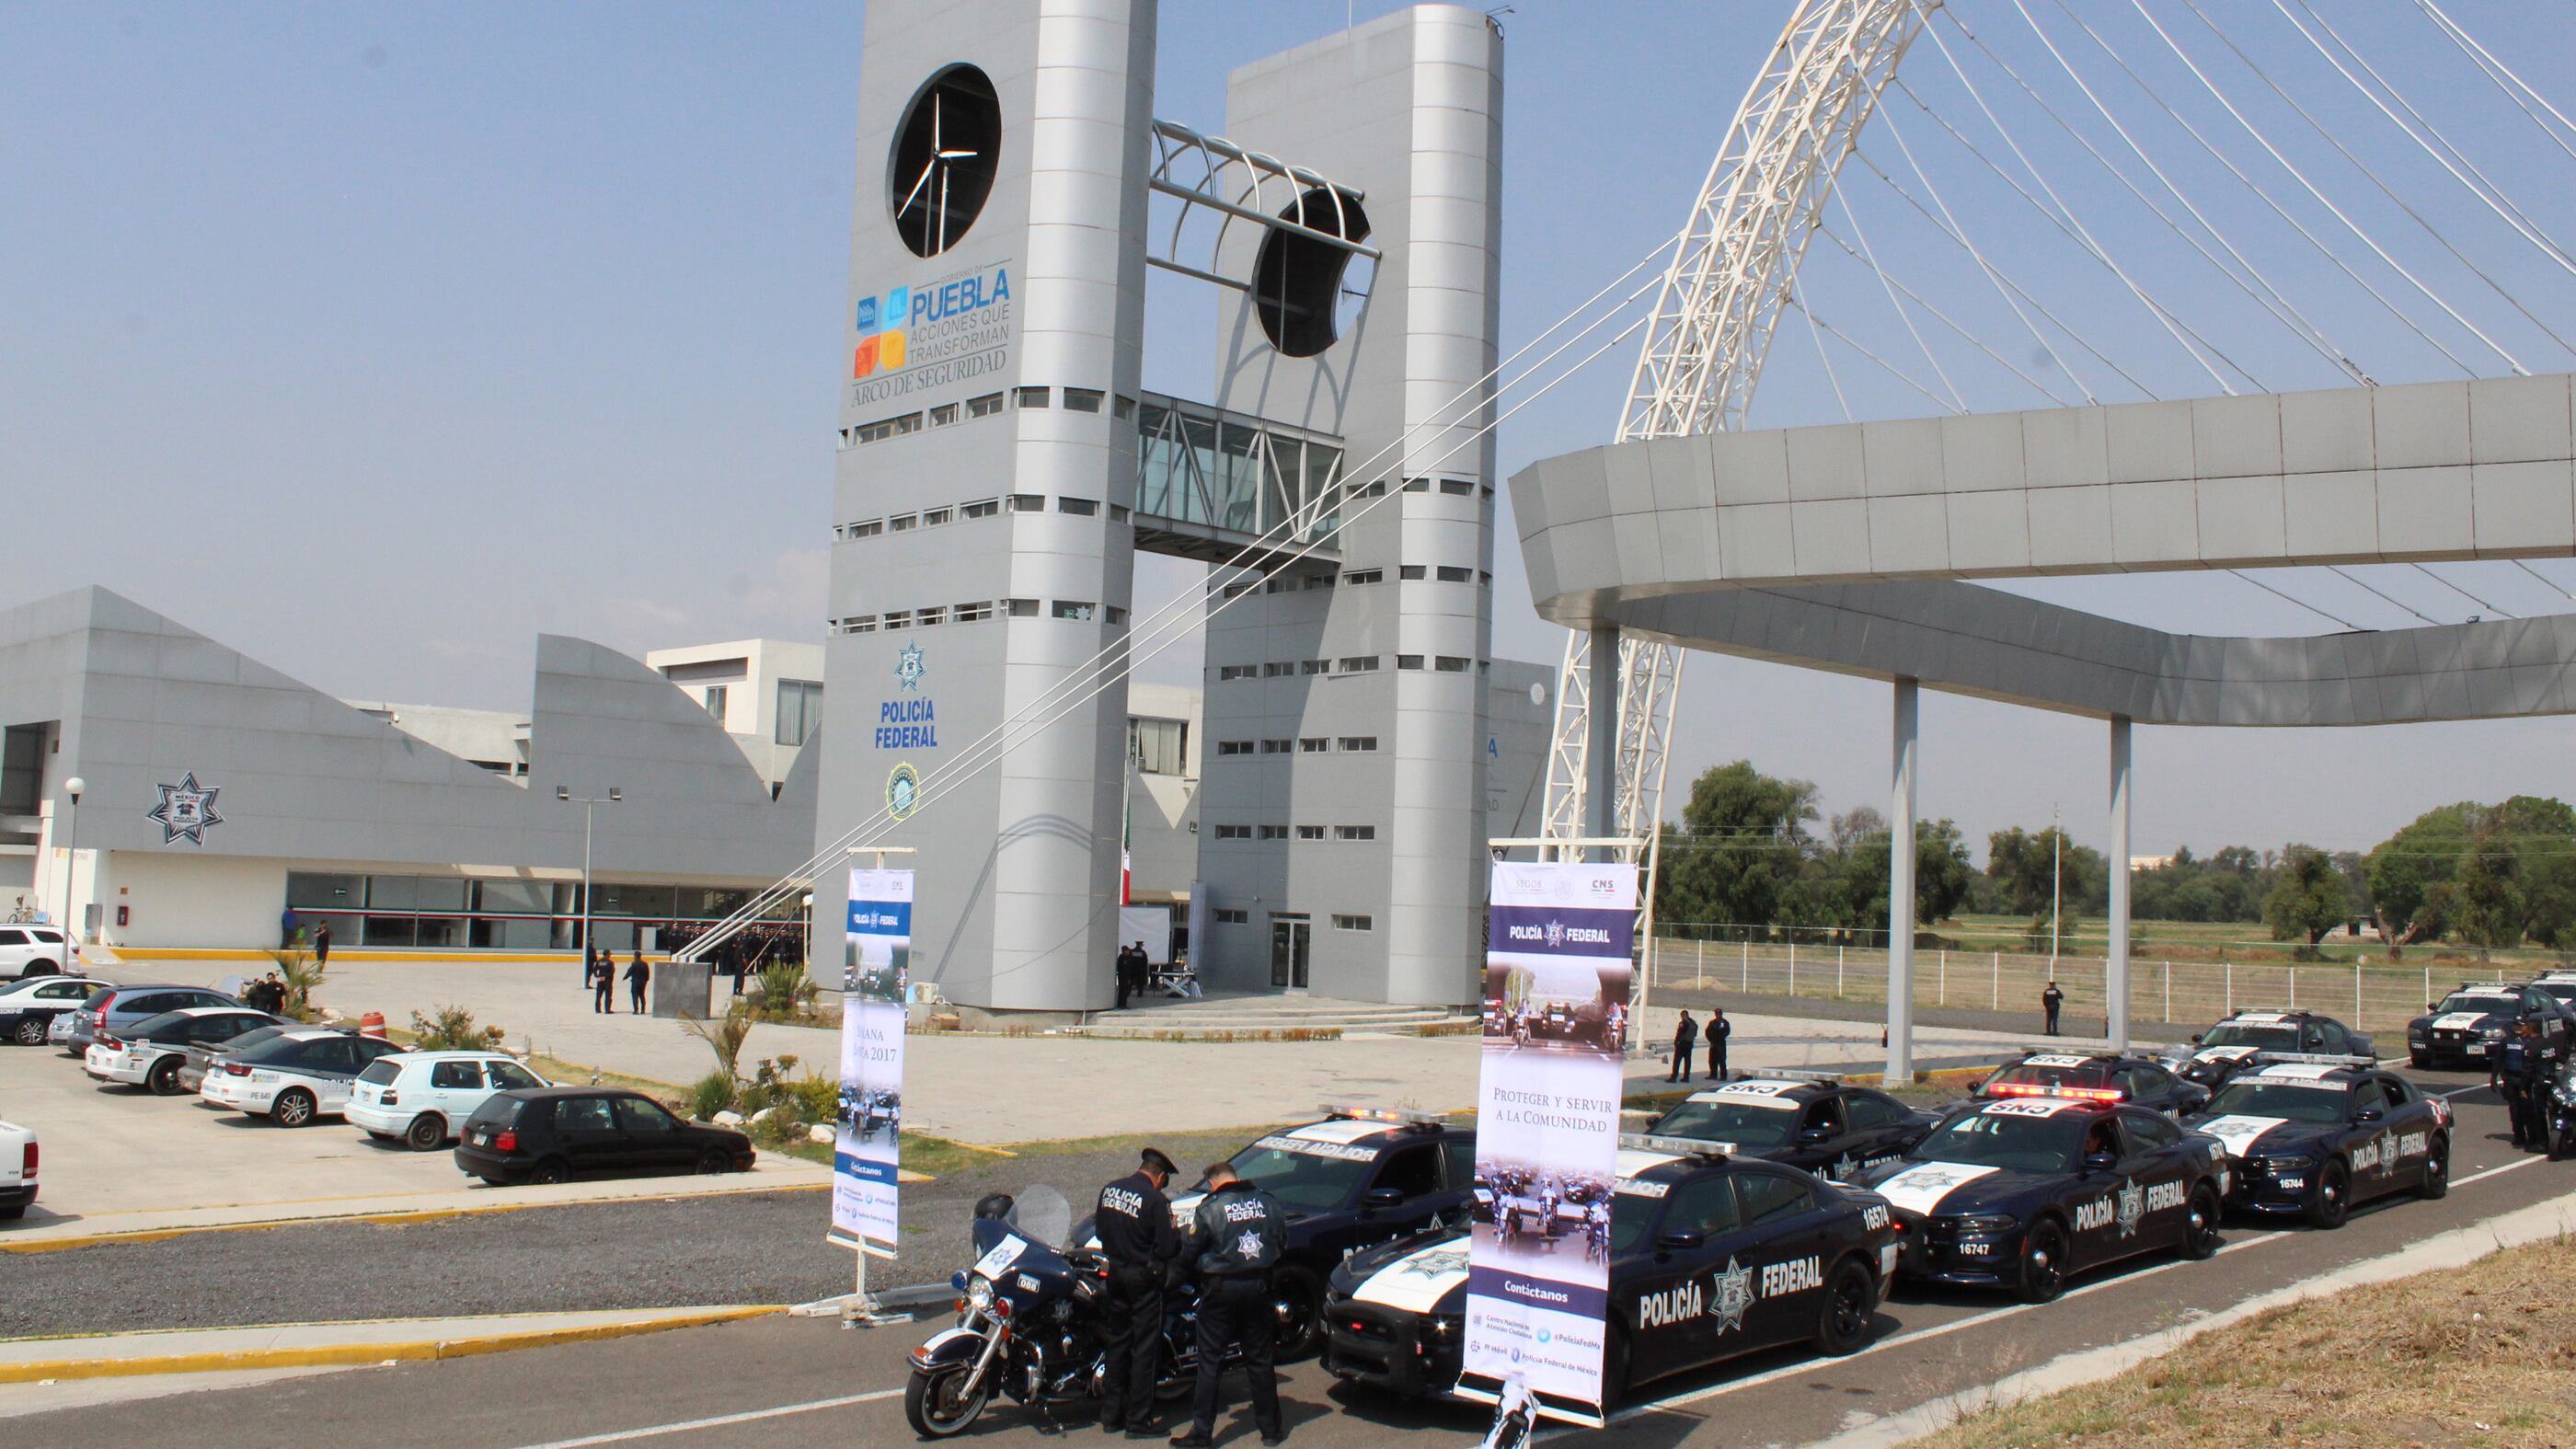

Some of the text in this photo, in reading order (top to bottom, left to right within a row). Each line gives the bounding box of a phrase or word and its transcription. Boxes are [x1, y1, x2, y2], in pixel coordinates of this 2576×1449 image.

[911, 269, 1010, 327] PUEBLA
[910, 304, 1010, 345] ACCIONES QUE
[909, 325, 1009, 364] TRANSFORMAN
[851, 350, 1007, 408] ARCO DE SEGURIDAD
[881, 696, 935, 723] POLICÍA
[875, 725, 938, 749] FEDERAL
[1592, 880, 1614, 889] CNS
[1509, 924, 1611, 943] POLICÍA FEDERAL
[870, 1047, 898, 1061] 2017
[1493, 1087, 1613, 1113] PROTEGER Y SERVIR
[1725, 1084, 1778, 1094] CNS
[1991, 1103, 2051, 1115] CNS
[1495, 1110, 1607, 1133] A LA COMUNIDAD
[2352, 1131, 2427, 1171] POLICÍA FEDERAL
[2279, 1178, 2305, 1189] 16744
[1103, 1187, 1143, 1209] POLICÍA
[1224, 1198, 1264, 1213] POLICÍA
[2076, 1179, 2186, 1232] POLICÍA FEDERAL
[1226, 1209, 1267, 1222] FEDERAL
[1863, 1204, 1890, 1231] 16574
[1960, 1243, 1990, 1255] 16747
[1504, 1280, 1569, 1303] Contáctanos
[1640, 1255, 1823, 1328] POLICÍA FEDERAL
[1486, 1315, 1504, 1325] Centro
[1544, 1357, 1568, 1370] Federal
[1576, 1365, 1598, 1377] México
